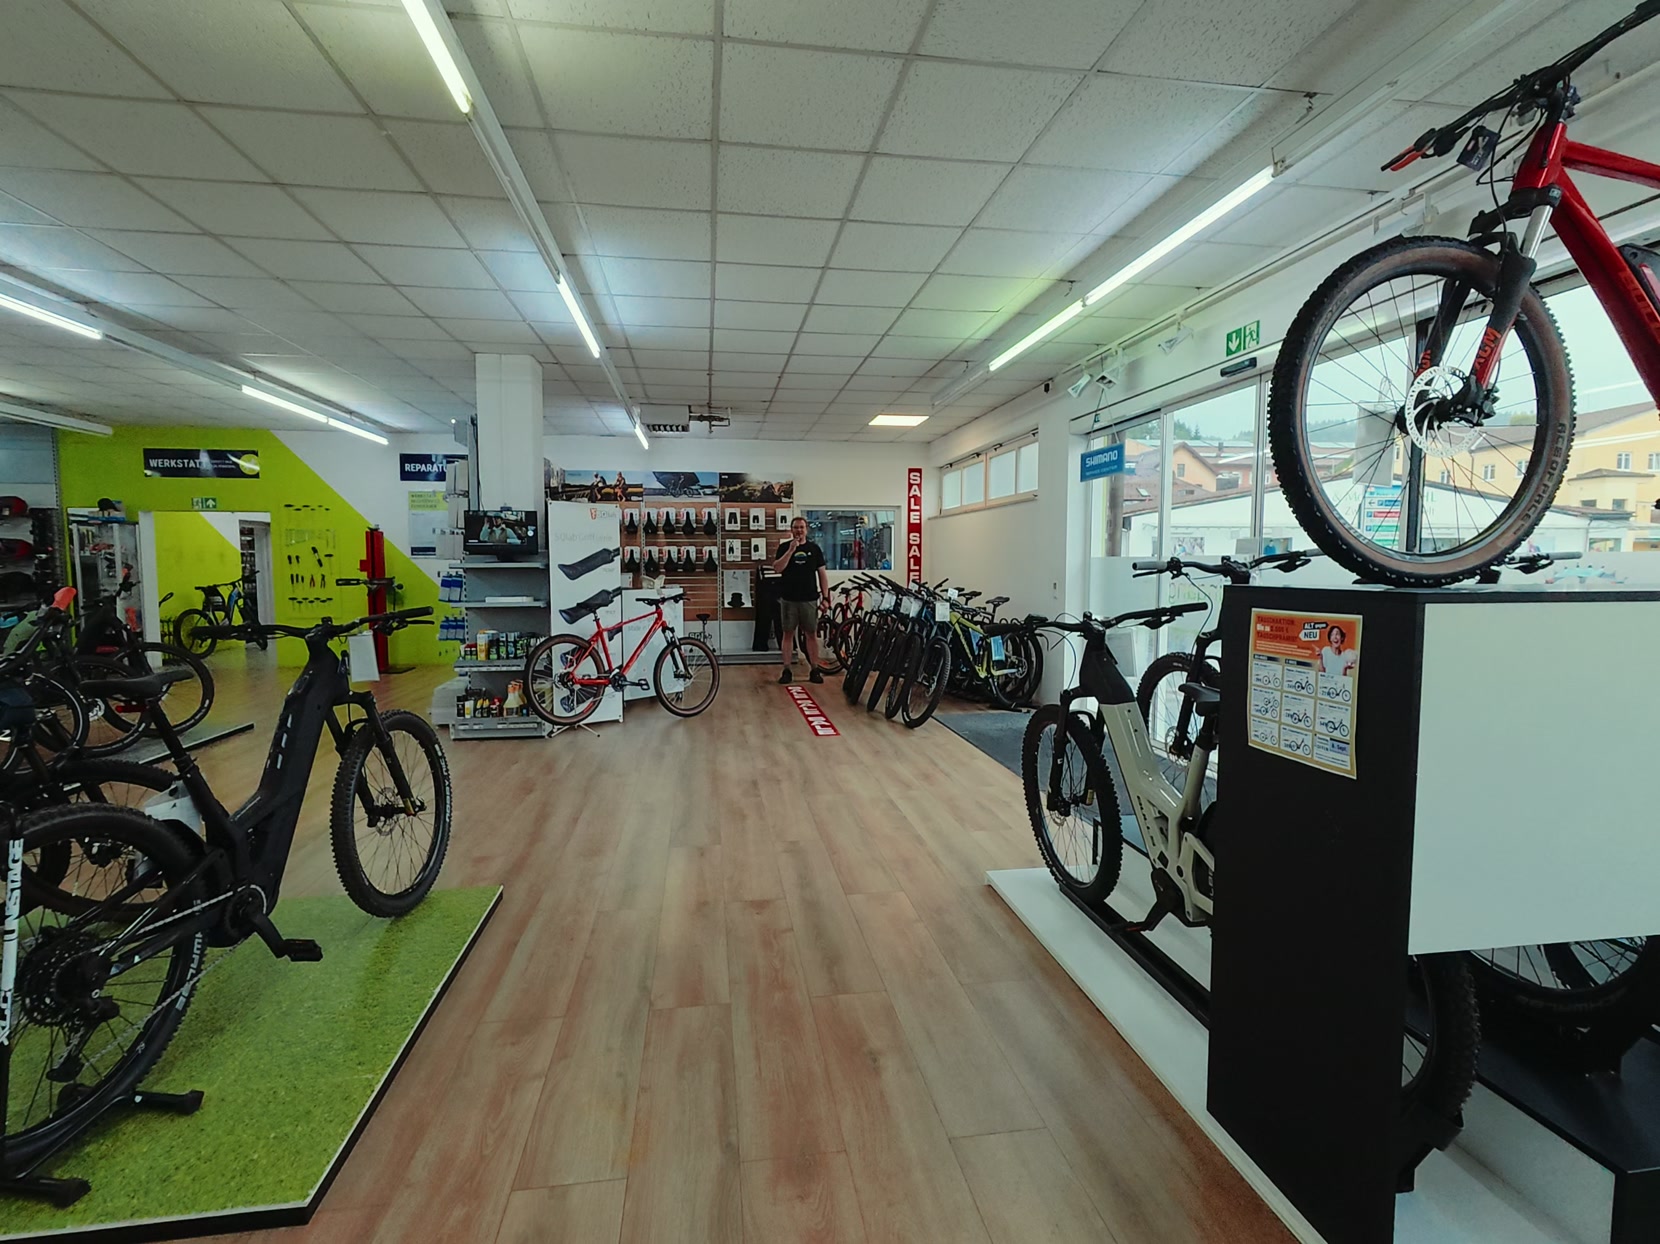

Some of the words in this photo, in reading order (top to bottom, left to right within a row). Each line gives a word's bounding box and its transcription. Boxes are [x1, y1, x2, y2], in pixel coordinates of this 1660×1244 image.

[1085, 450, 1118, 467] SHIMANO
[909, 472, 921, 524] SALE
[909, 532, 921, 583] SALE
[1303, 631, 1318, 640] NEU
